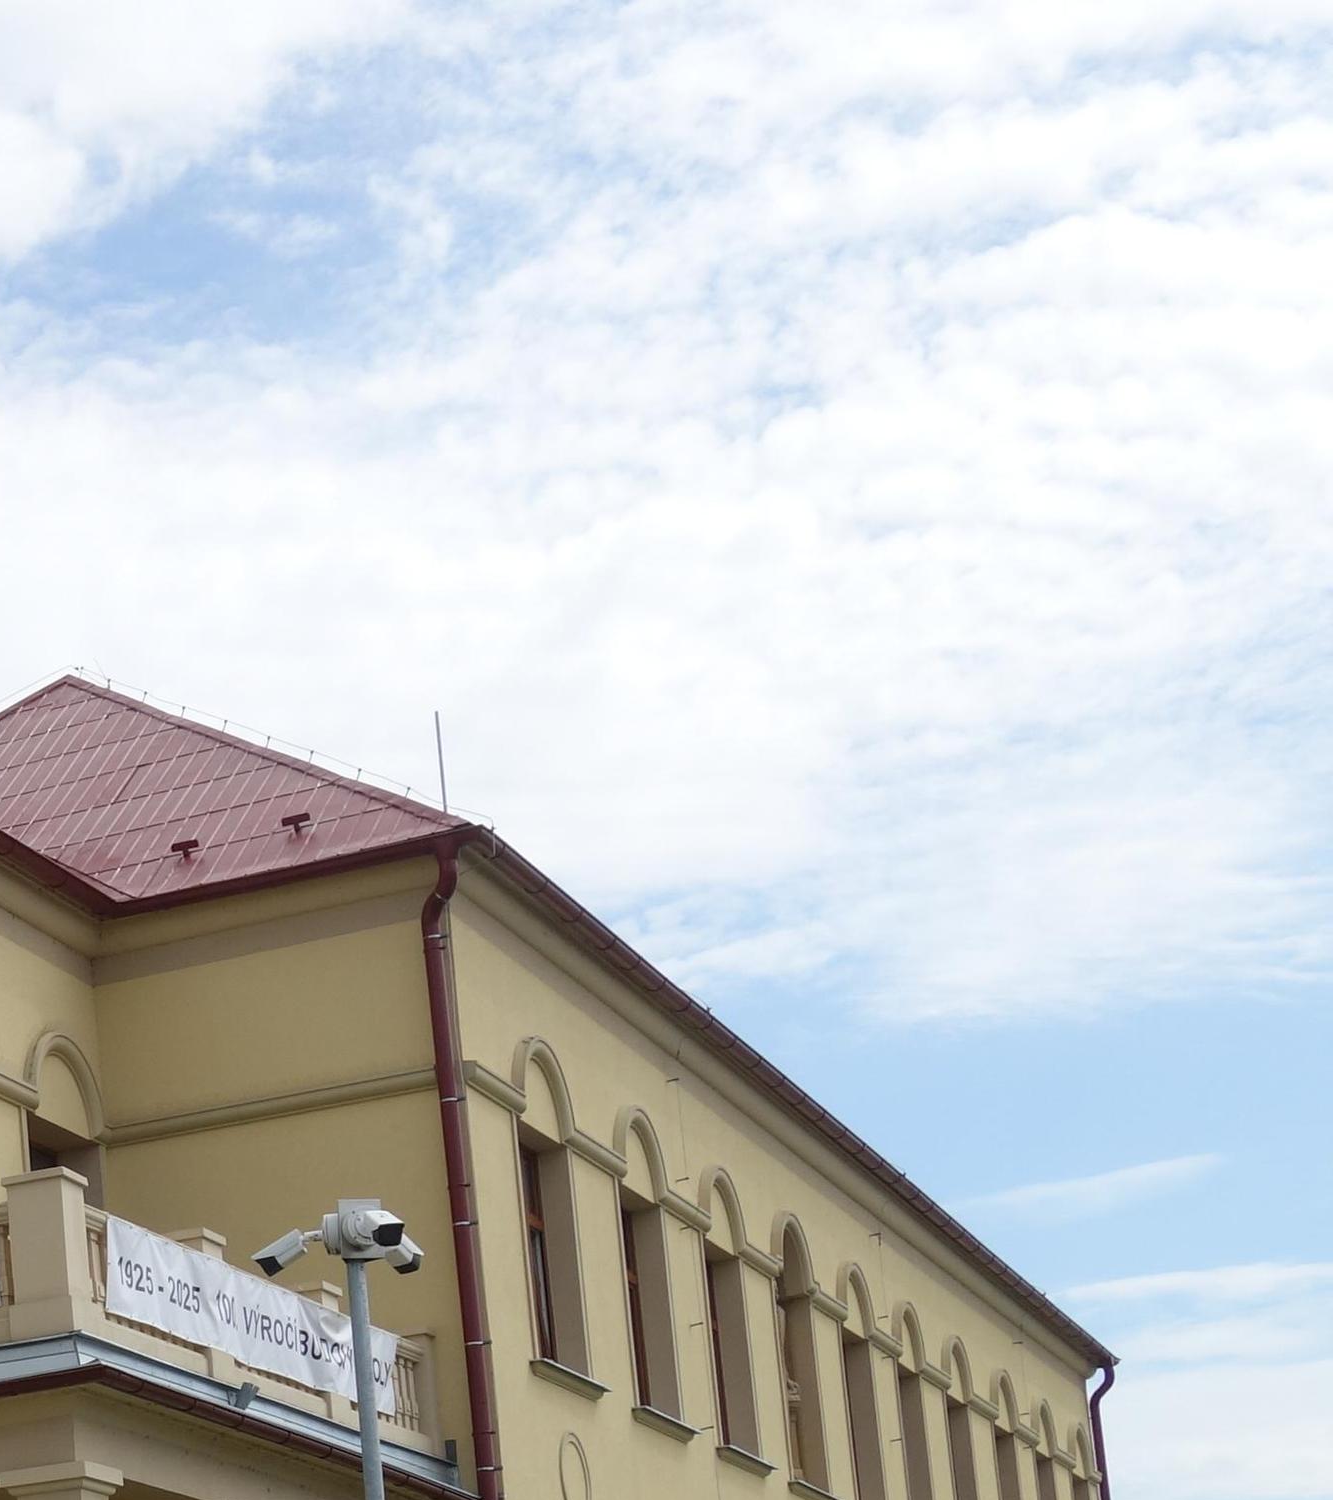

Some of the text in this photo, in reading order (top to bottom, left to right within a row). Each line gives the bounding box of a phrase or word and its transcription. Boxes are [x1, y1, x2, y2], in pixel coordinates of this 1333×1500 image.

[118, 1256, 154, 1295] 1925
[168, 1276, 200, 1314] 2025
[243, 1304, 298, 1353] VÝROČÍ
